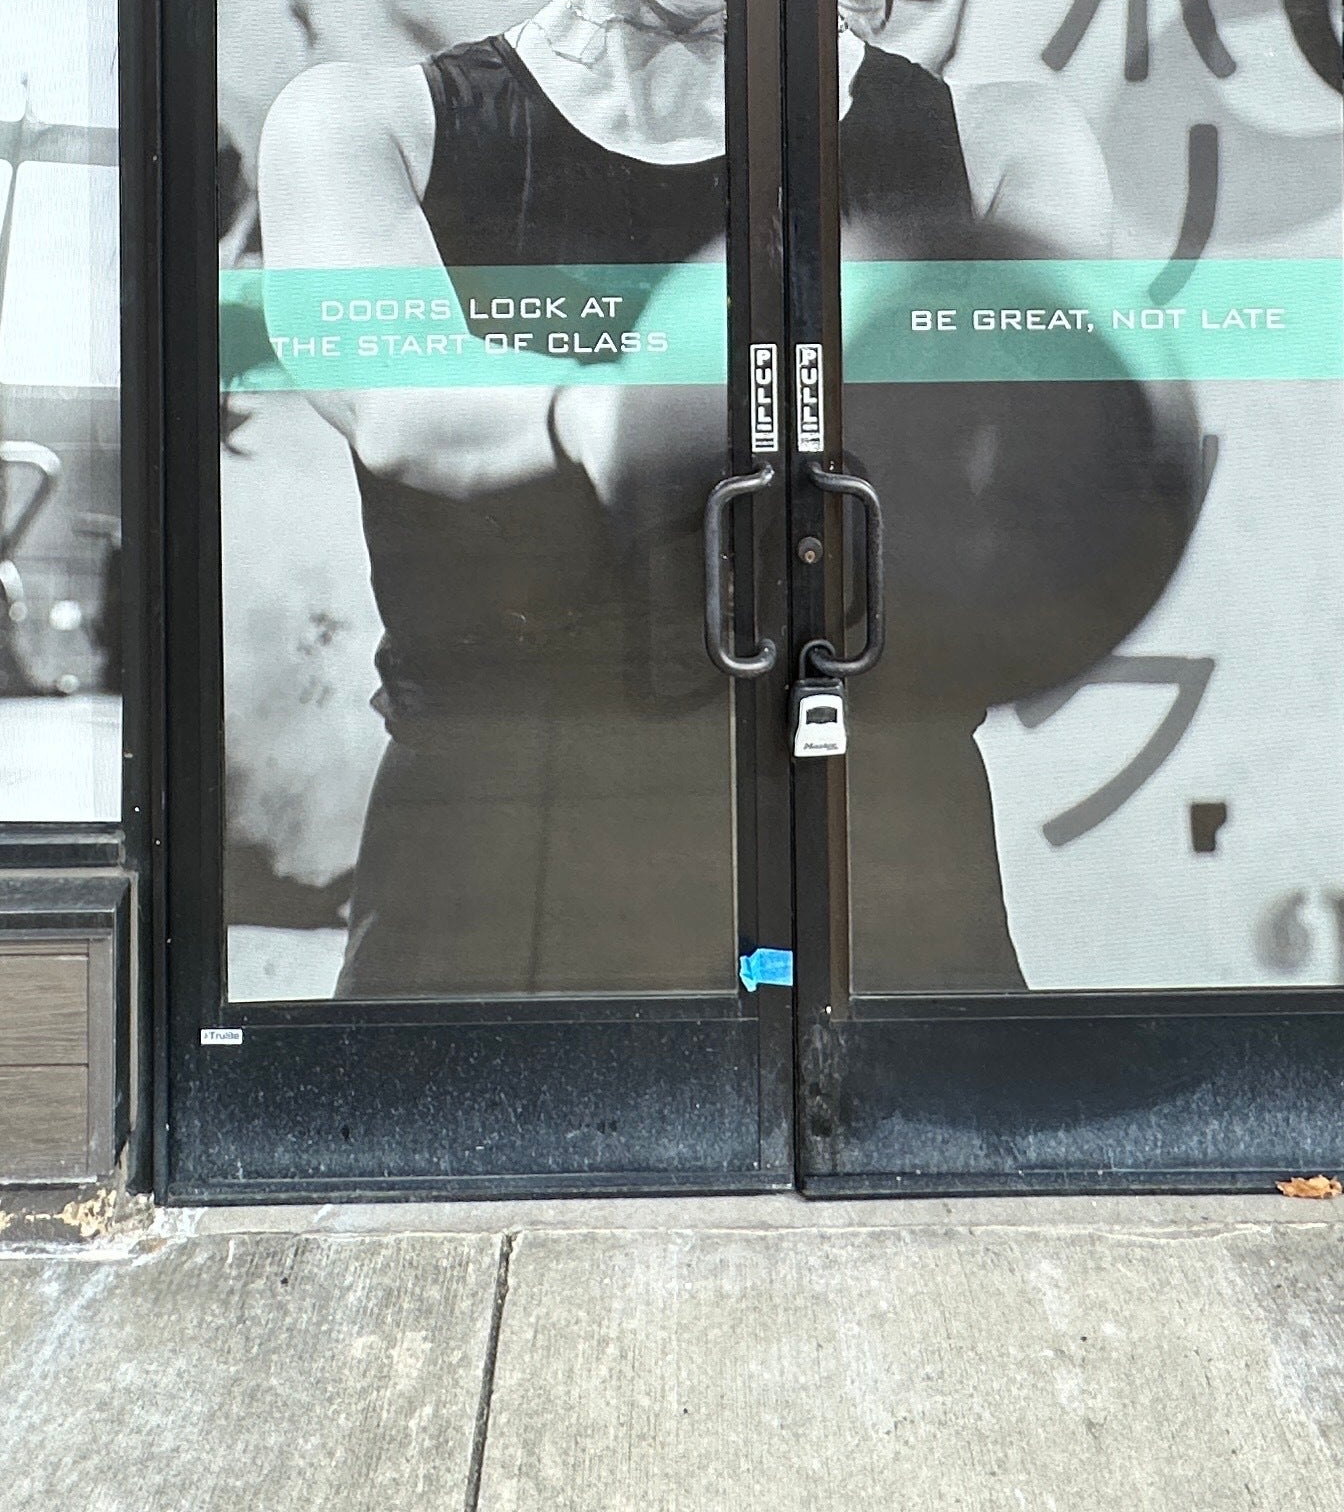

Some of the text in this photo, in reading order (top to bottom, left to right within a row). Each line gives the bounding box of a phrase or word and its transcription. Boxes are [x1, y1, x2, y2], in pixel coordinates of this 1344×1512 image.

[320, 296, 624, 322] DOORS LOCK AT
[910, 307, 1286, 333] BE GREAT, NOT LATE
[270, 331, 669, 359] THE START OF CLASS
[755, 349, 772, 423] PULL
[800, 348, 818, 423] PULL
